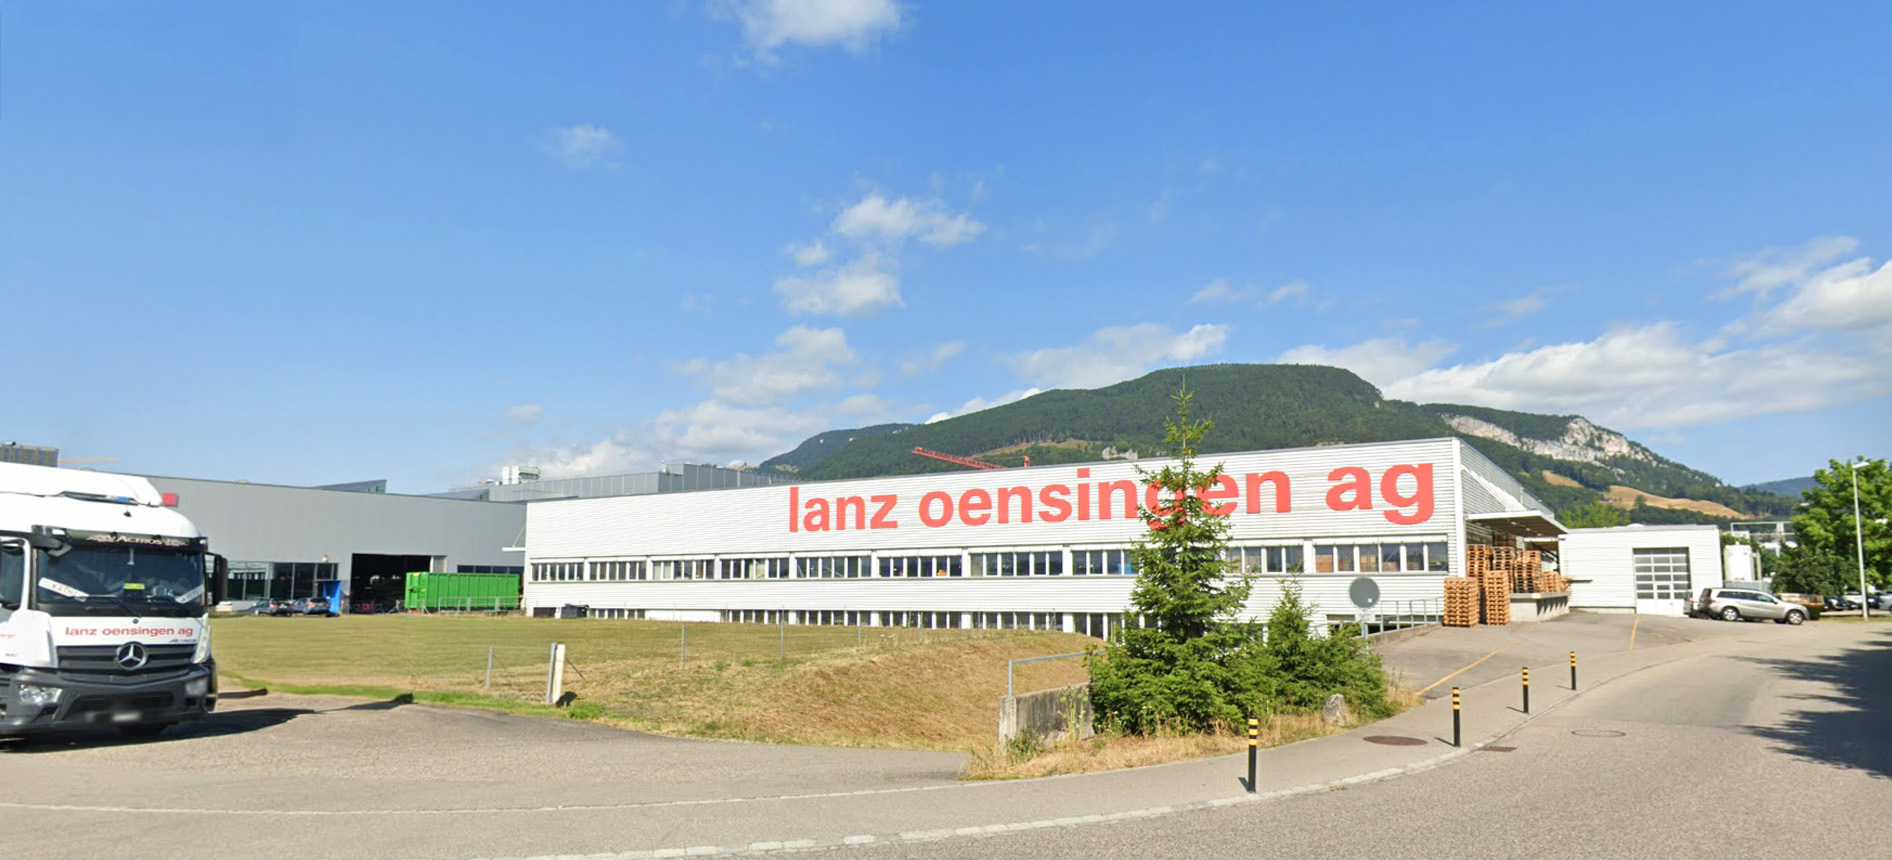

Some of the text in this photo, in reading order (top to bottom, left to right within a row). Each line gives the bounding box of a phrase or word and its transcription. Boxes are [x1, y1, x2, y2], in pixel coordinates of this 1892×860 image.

[789, 462, 1435, 532] lanz oensingen ag
[65, 627, 193, 637] lanz oensingen ag
